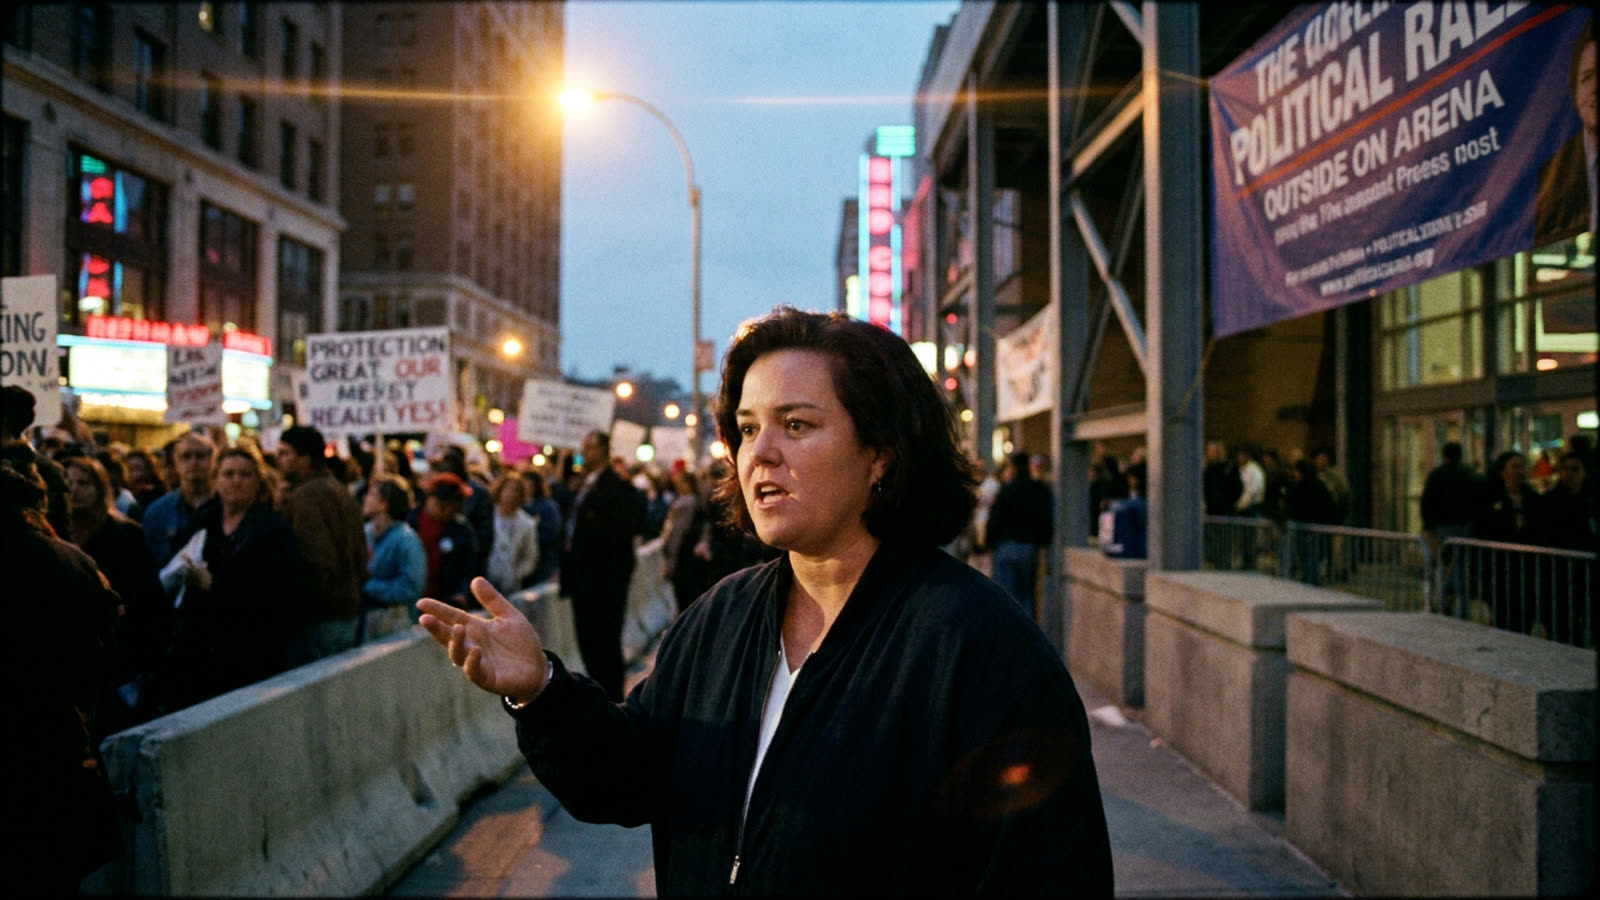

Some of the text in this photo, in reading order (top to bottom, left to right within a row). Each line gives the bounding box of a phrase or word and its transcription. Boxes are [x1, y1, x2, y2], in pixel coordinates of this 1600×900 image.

[1255, 32, 1299, 105] THE
[1230, 31, 1394, 186] POLITICAL
[1263, 150, 1350, 221] OUTSIDE
[1352, 128, 1388, 178] ON
[1393, 69, 1504, 159] ARENA
[0, 311, 46, 343] ING
[311, 336, 445, 358] PROTECTION
[311, 357, 441, 382] GREAT OUR
